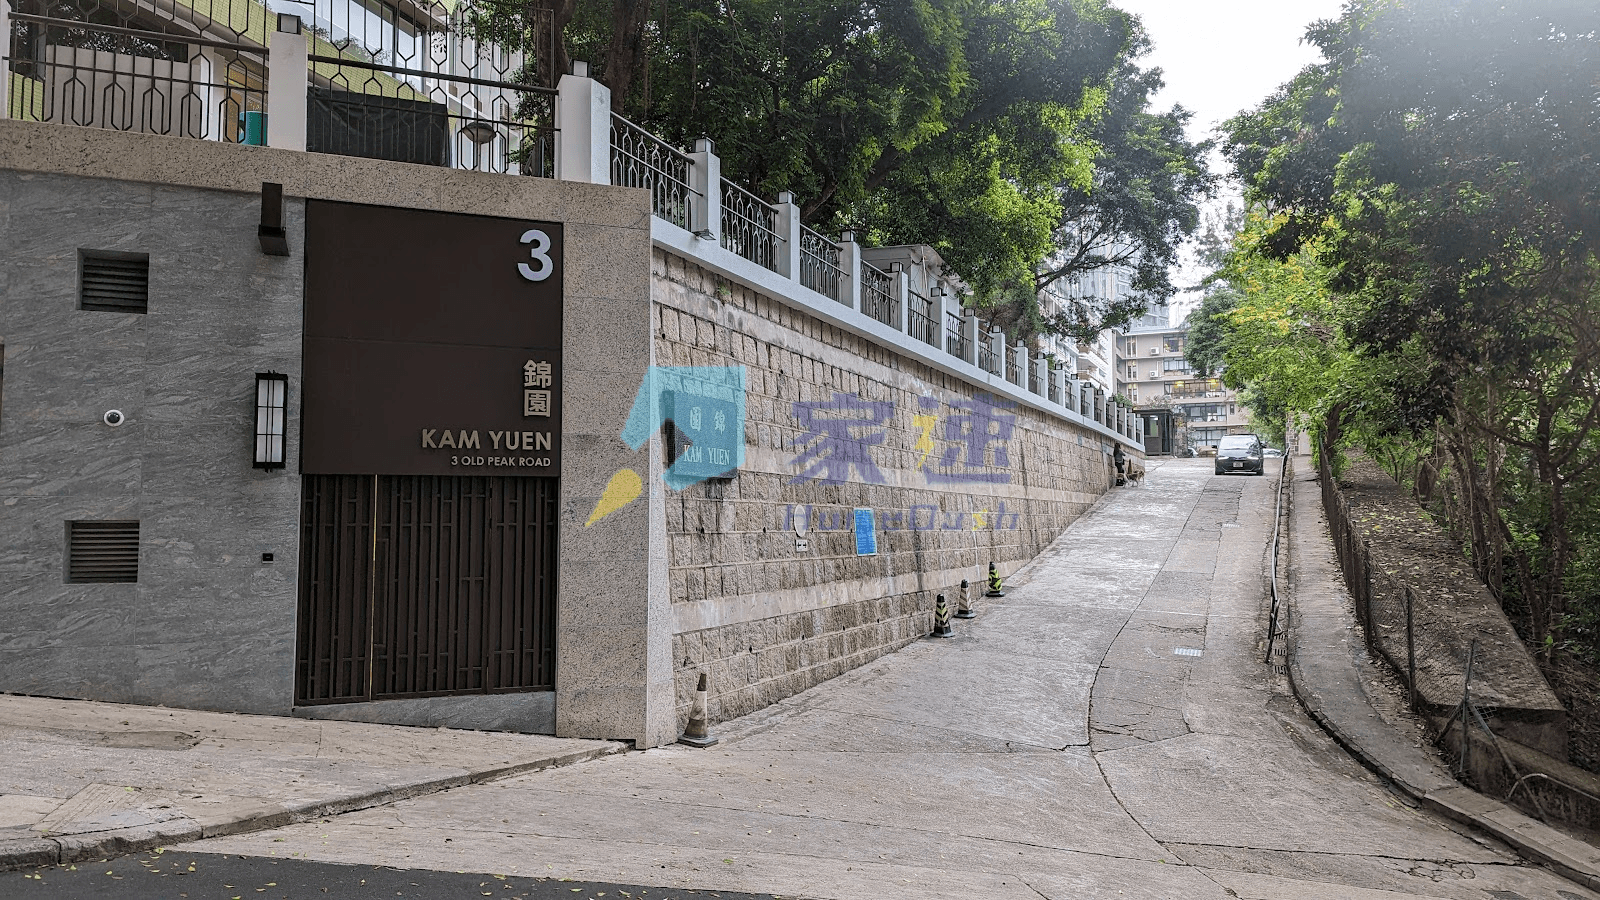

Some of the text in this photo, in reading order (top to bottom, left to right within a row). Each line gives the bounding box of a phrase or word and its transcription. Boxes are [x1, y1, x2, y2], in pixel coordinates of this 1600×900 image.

[517, 229, 554, 282] 3
[523, 359, 552, 418] 錦園
[421, 428, 552, 451] KAM YUEN
[451, 455, 551, 467] 3 OLD PEAK ROAD
[683, 444, 730, 466] KAM YUEN
